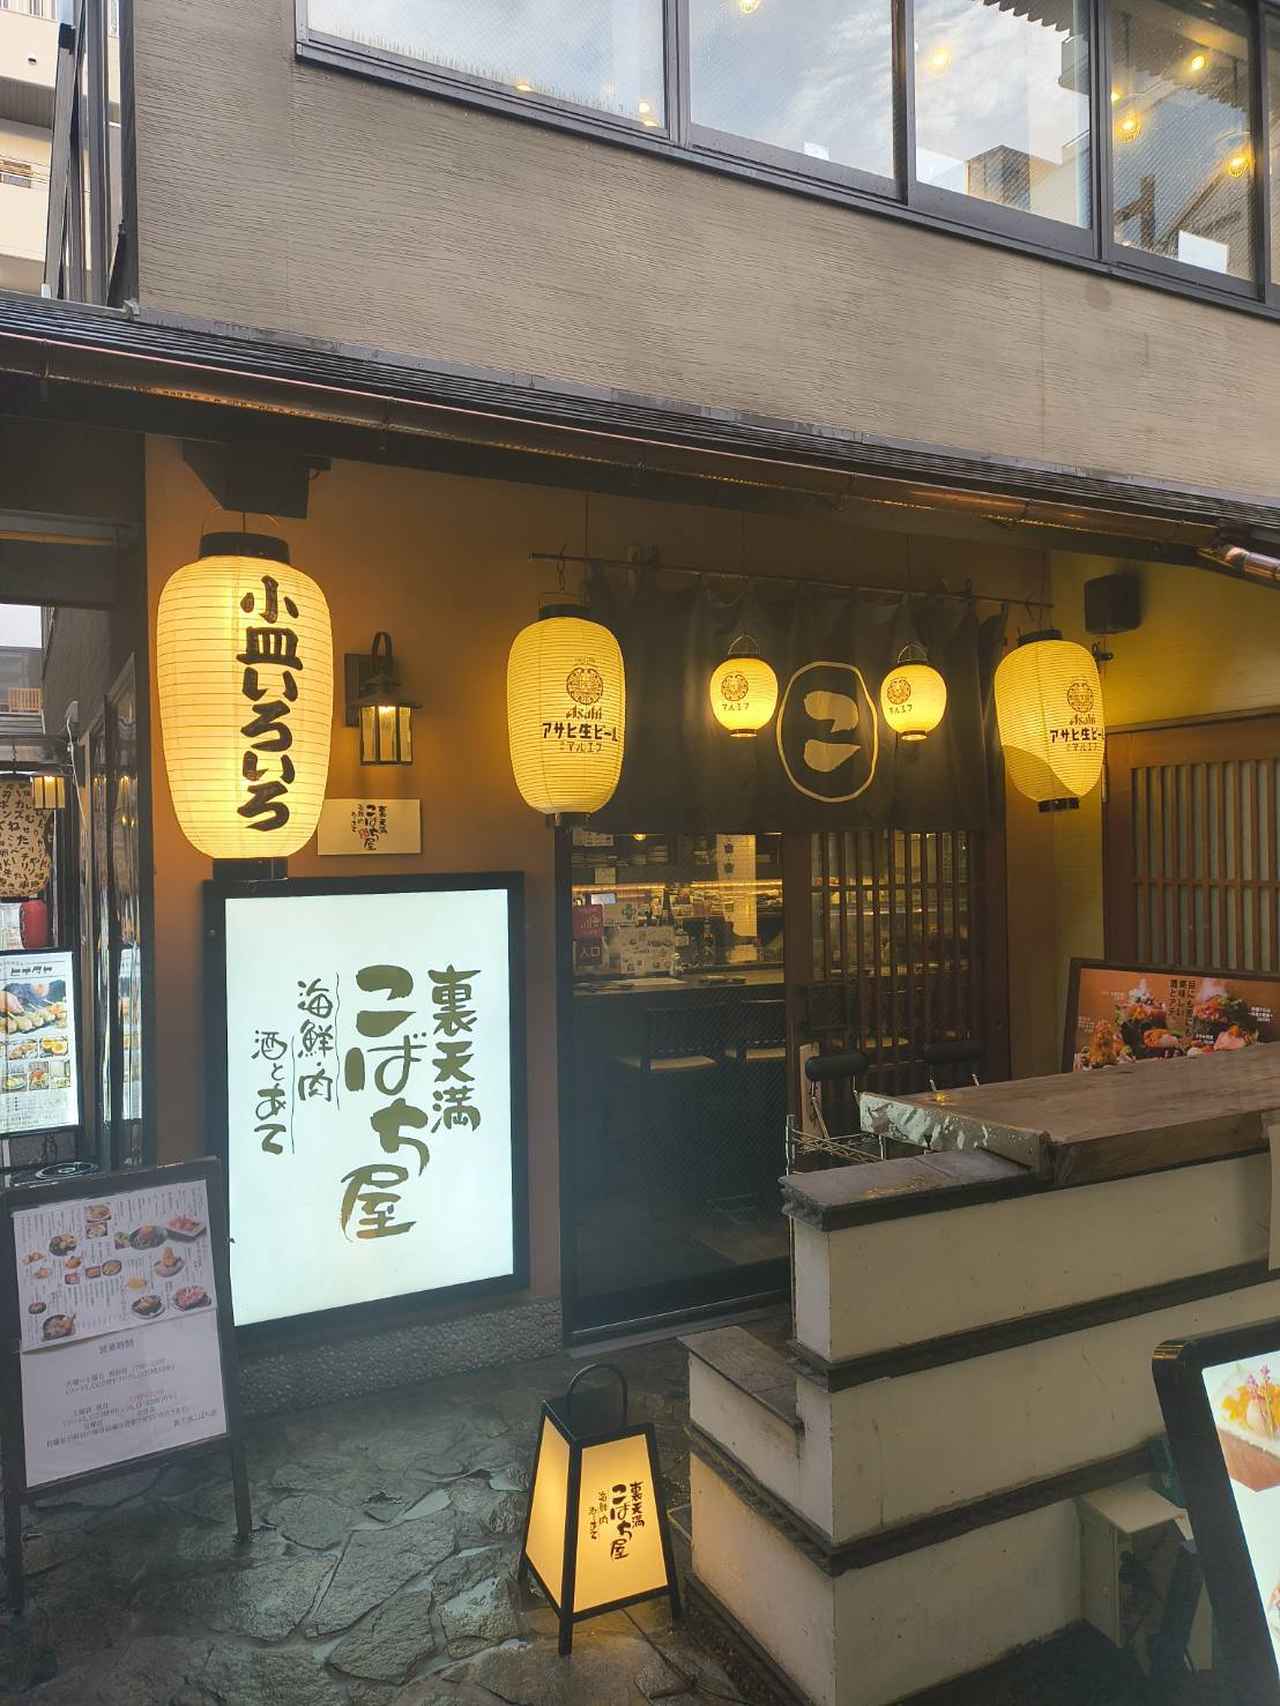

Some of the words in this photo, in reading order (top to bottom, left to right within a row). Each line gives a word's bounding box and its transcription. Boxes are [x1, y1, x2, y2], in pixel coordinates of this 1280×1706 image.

[236, 575, 303, 832] 小皿いろいろ
[542, 722, 618, 742] アサヒ生ビール
[251, 1029, 288, 1155] 酒とあて
[297, 978, 334, 1102] 海鮮・肉
[427, 964, 481, 1134] 裏天満
[340, 964, 431, 1243] こばち屋
[610, 1483, 632, 1560] こばち屋
